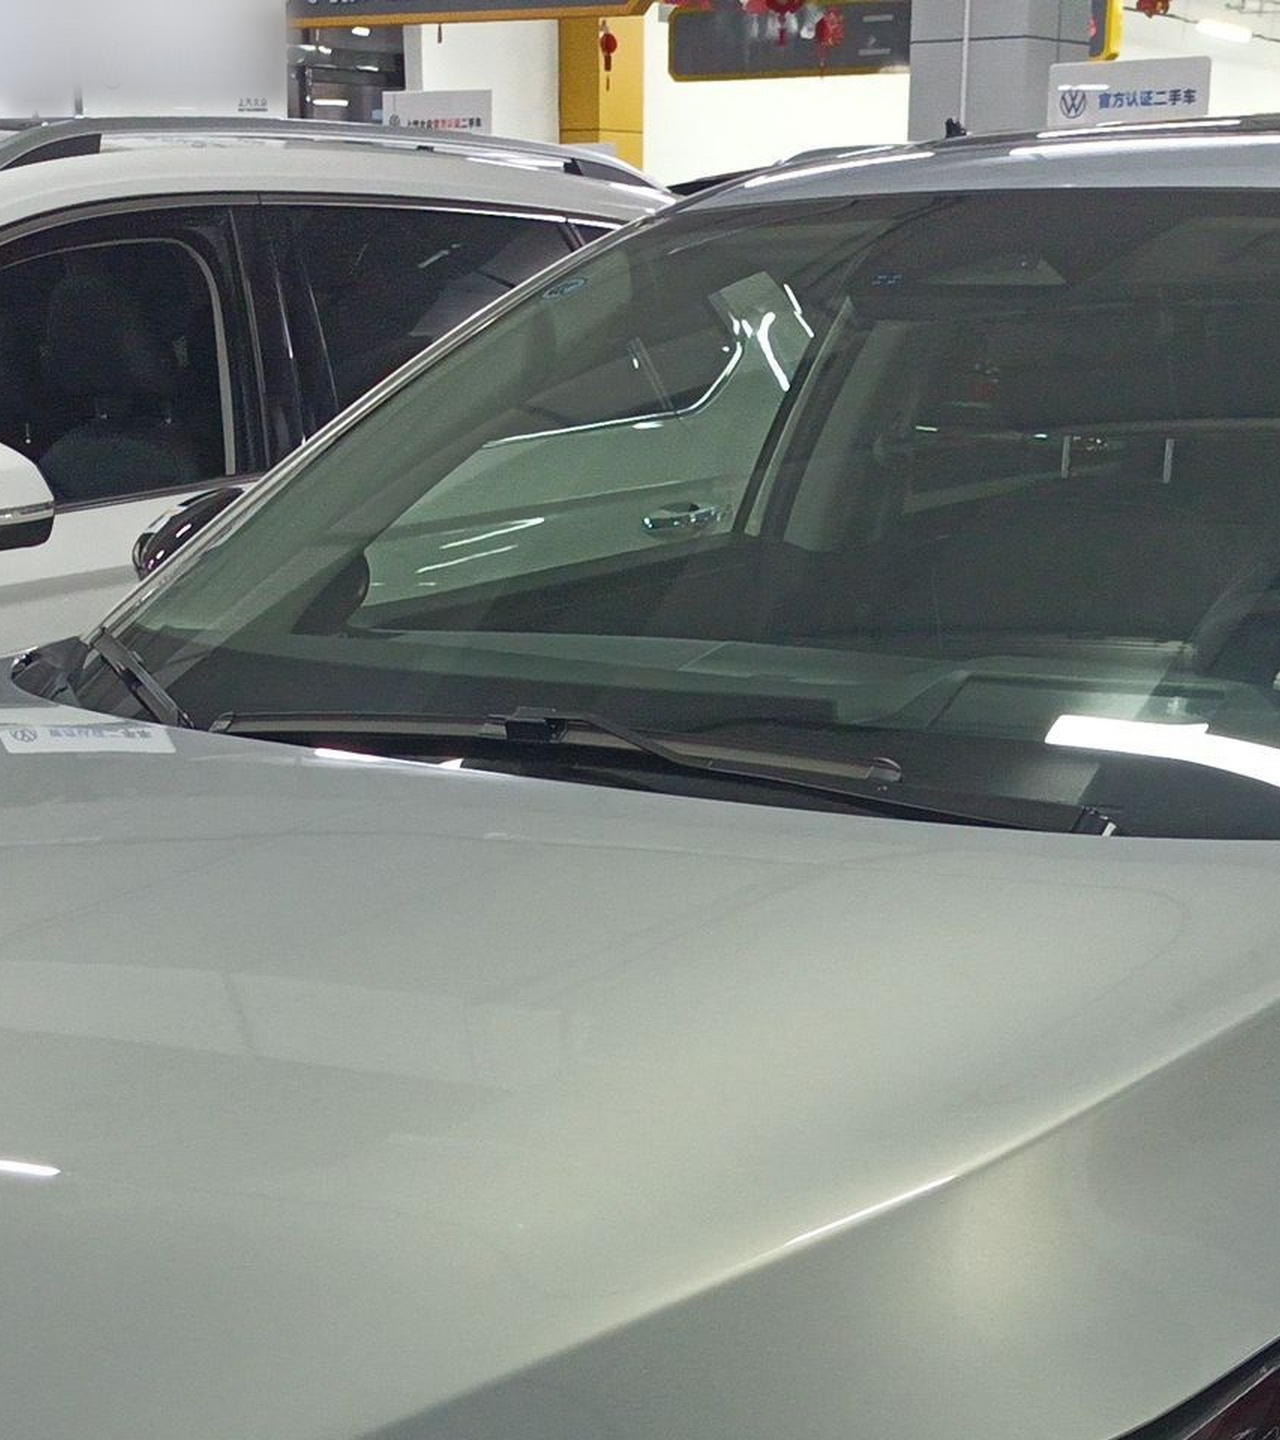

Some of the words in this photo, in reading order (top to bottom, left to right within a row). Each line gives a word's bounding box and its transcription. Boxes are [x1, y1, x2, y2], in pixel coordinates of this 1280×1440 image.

[1098, 88, 1197, 110] 官方认证二手车
